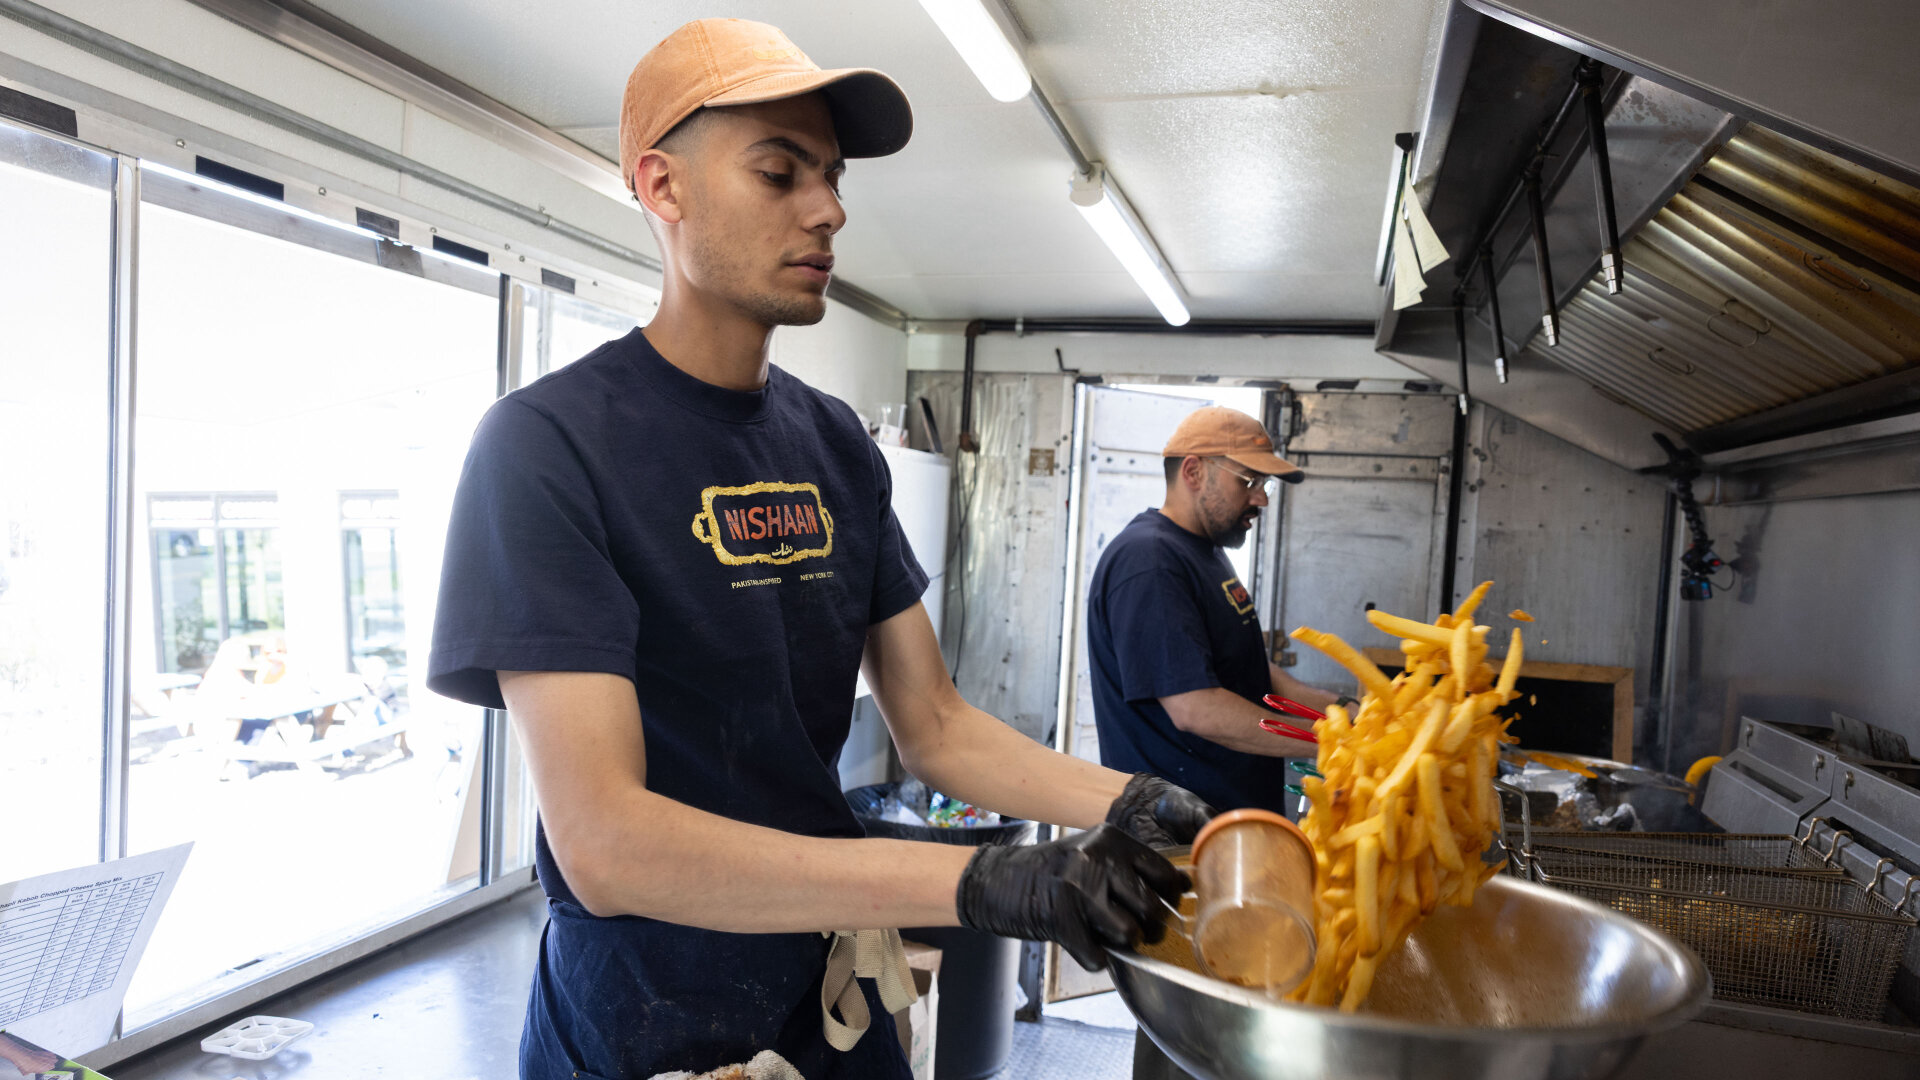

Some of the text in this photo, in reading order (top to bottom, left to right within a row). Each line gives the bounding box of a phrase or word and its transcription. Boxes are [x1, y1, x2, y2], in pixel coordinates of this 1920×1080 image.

[723, 504, 819, 541] NISHAAN
[800, 573, 814, 582] NEW
[40, 888, 70, 898] Chopped
[70, 884, 94, 892] Cheese
[94, 879, 112, 888] Spice
